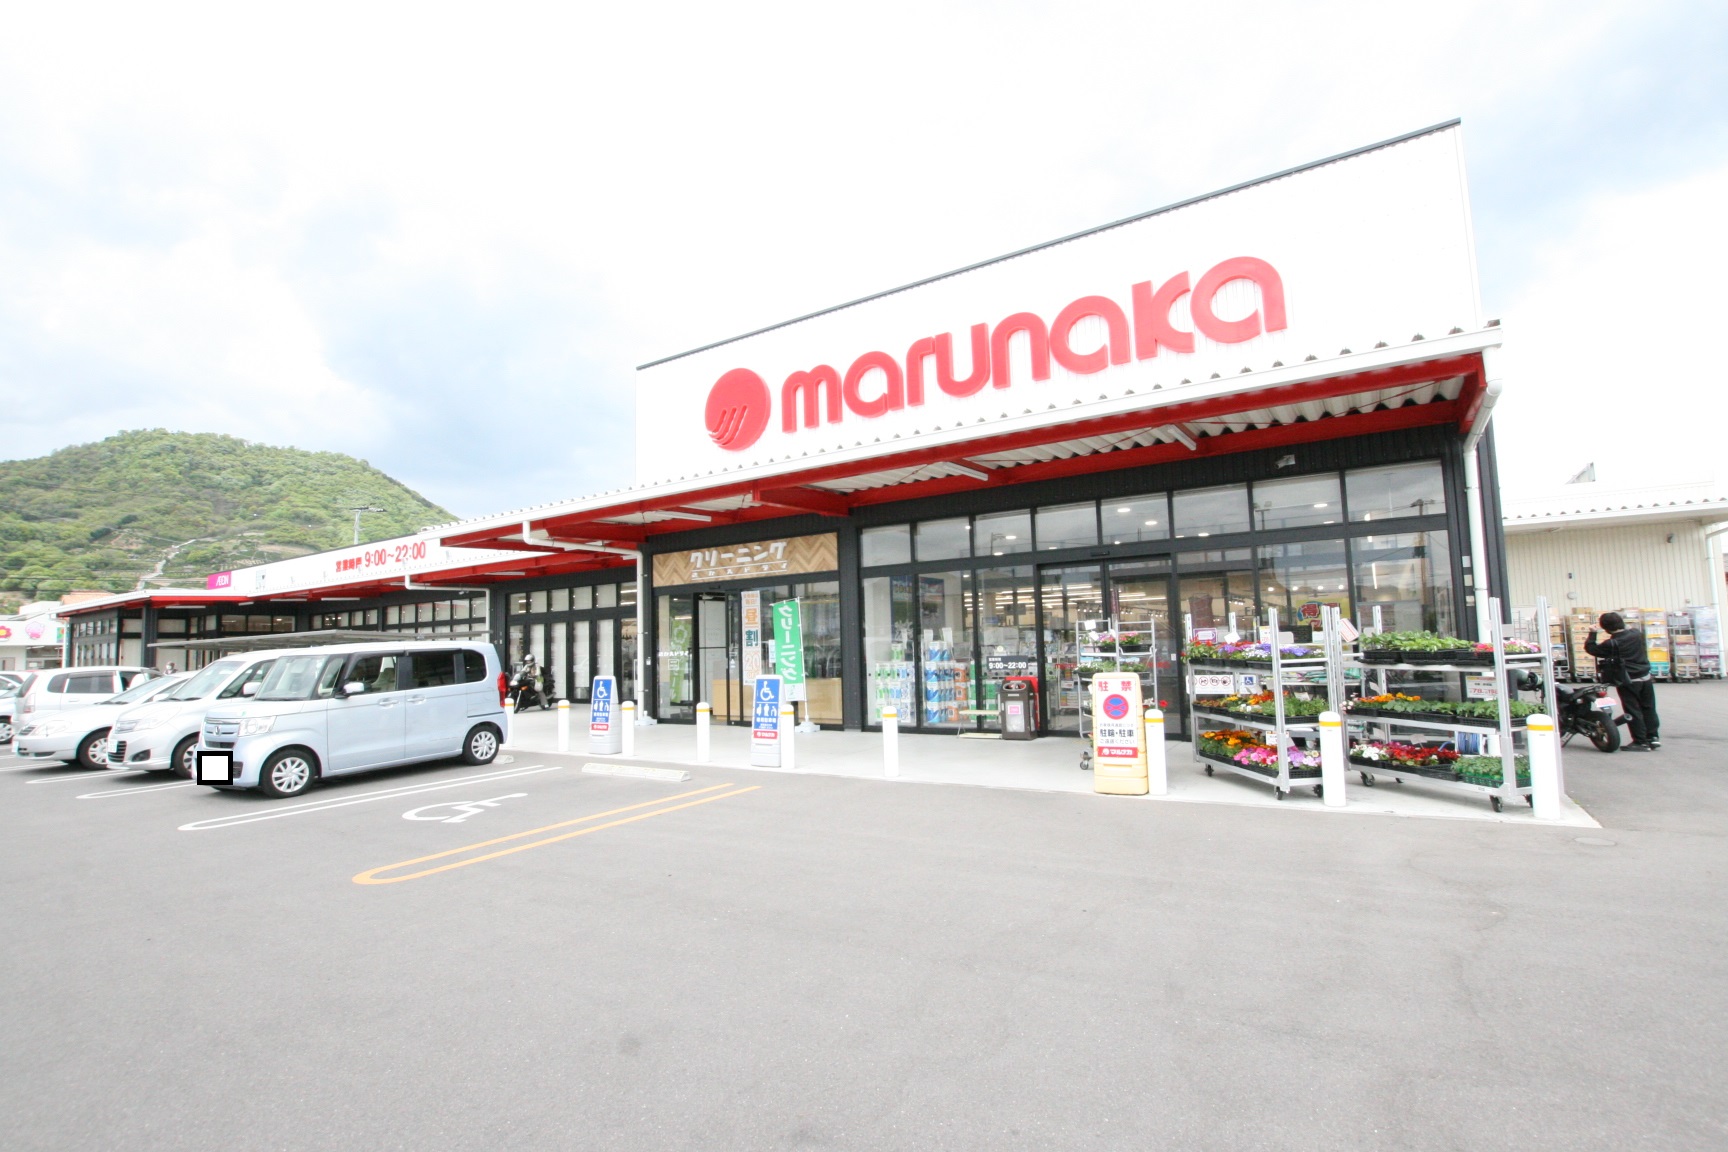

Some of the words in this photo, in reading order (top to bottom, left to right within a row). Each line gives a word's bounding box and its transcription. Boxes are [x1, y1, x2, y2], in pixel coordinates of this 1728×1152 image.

[782, 256, 1287, 433] marunaka
[690, 542, 787, 568] クリーニング
[778, 605, 797, 680] クリーニング
